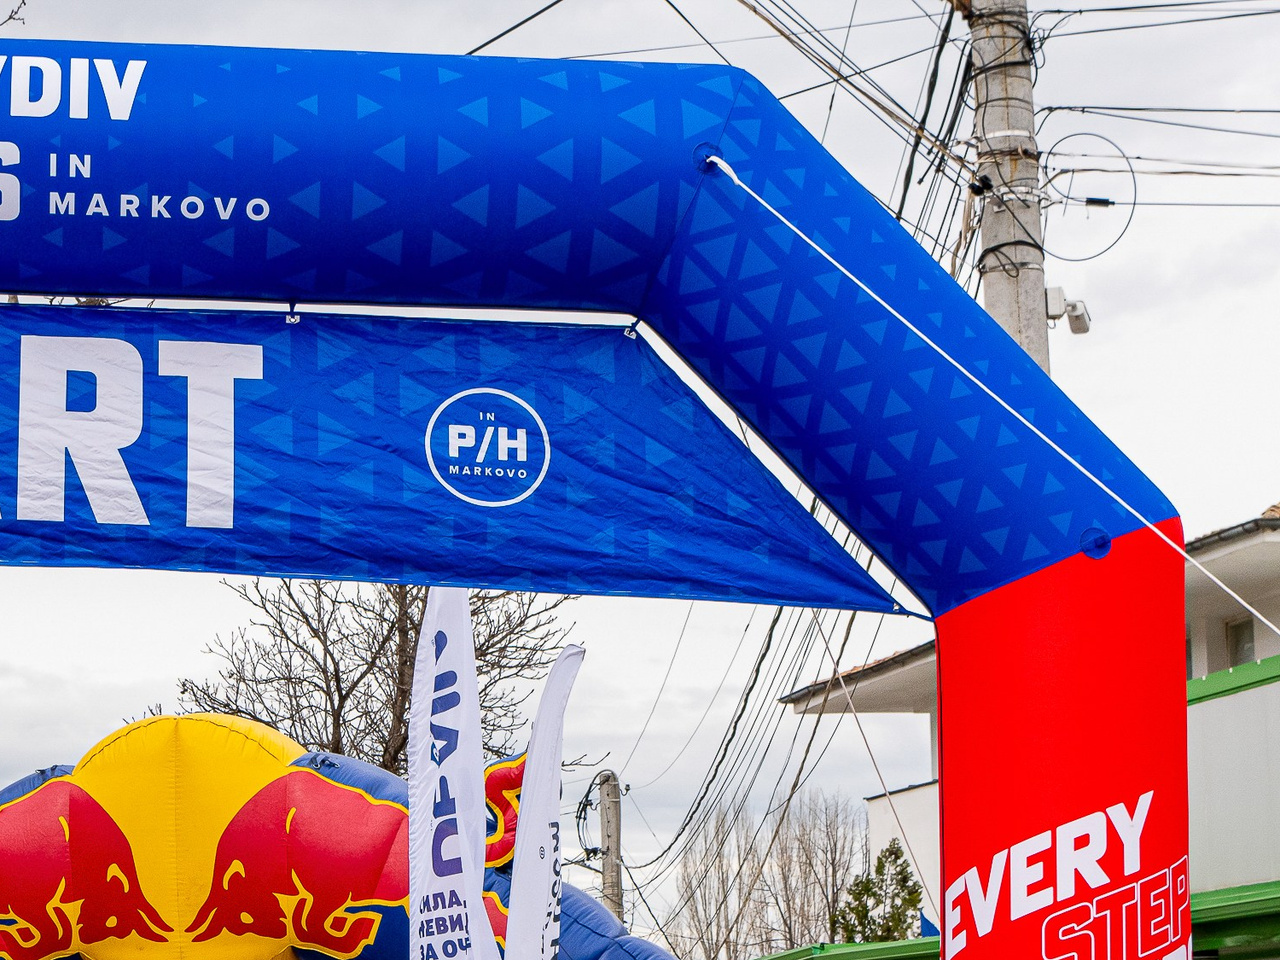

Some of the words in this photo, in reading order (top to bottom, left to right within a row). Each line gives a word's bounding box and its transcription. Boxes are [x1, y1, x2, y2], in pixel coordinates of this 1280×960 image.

[49, 152, 91, 179] IN
[48, 191, 270, 222] MARKOVO
[479, 411, 495, 421] IN
[448, 424, 528, 463] P/H
[448, 465, 528, 478] MARKOVO
